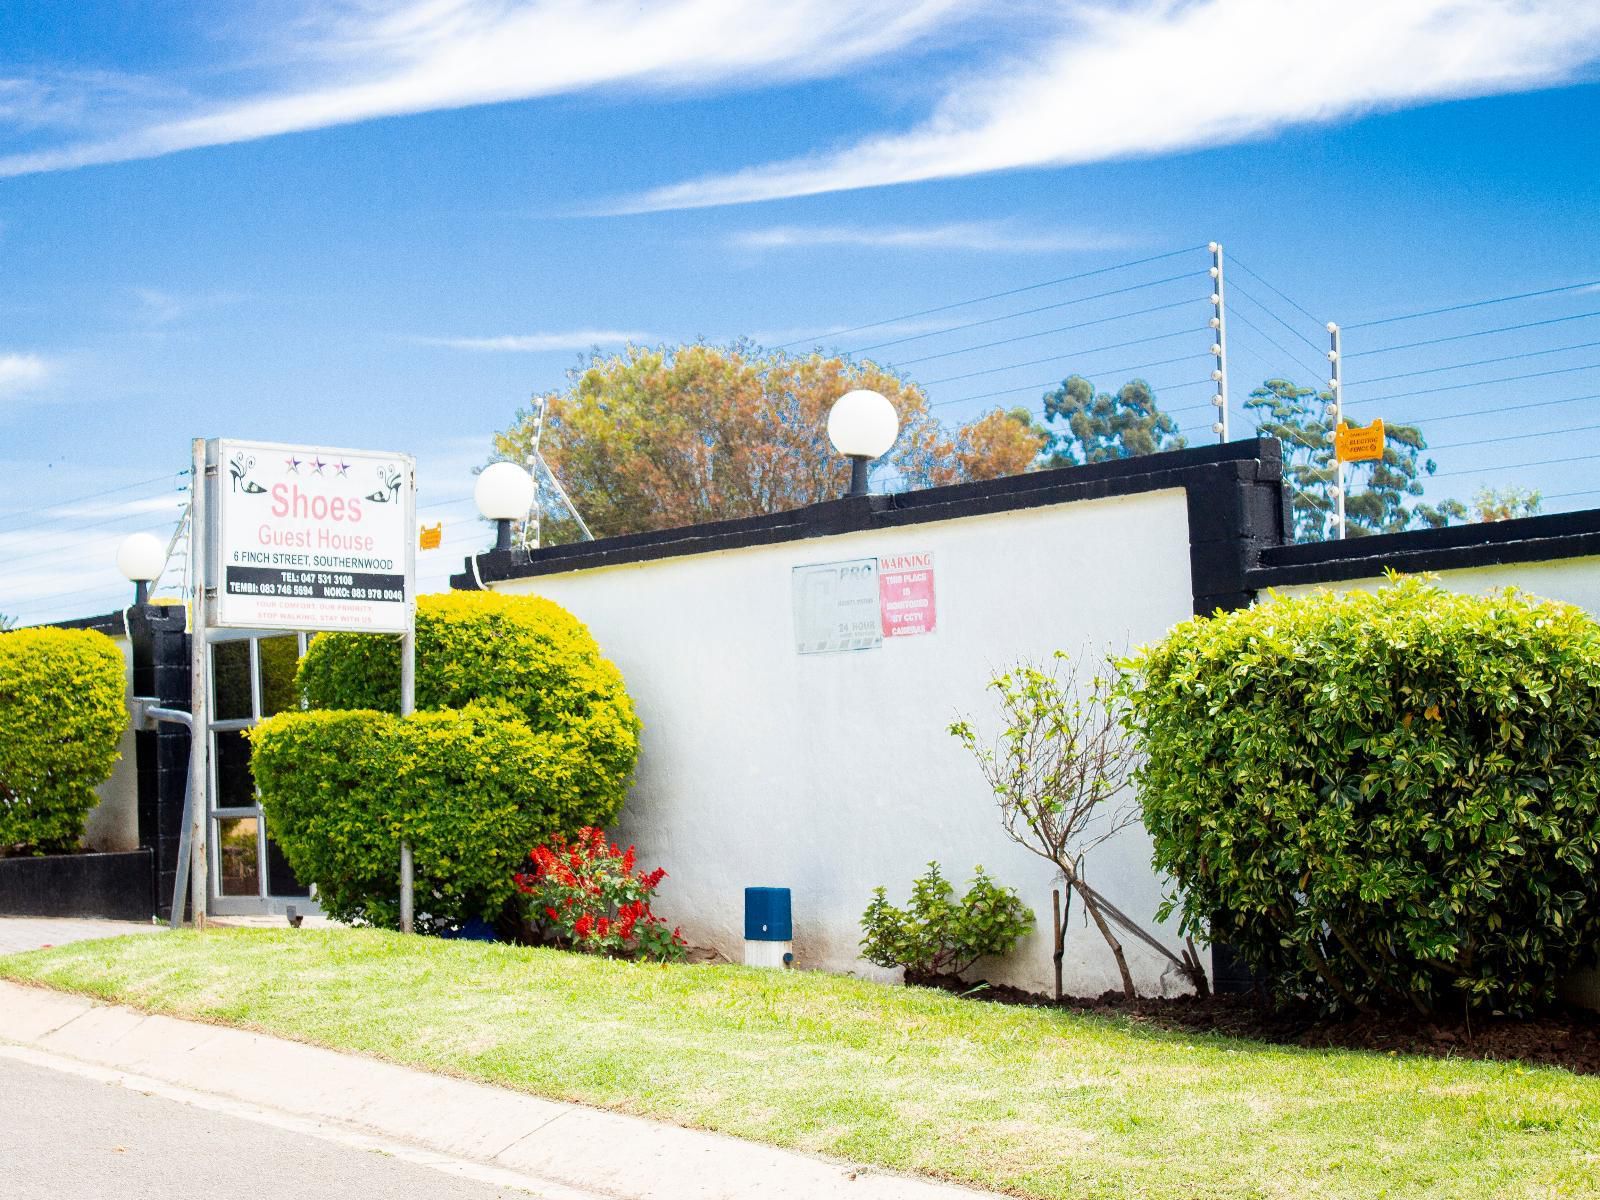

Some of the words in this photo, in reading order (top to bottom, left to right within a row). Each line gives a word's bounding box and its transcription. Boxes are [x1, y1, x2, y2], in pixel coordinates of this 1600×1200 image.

[271, 482, 362, 522] Shoes
[258, 524, 311, 548] Guest
[318, 527, 374, 551] House
[233, 550, 239, 562] 6
[241, 551, 270, 564] FINCH
[272, 553, 311, 567] STREET,
[313, 555, 393, 570] SOUTHERNWOOD
[881, 554, 930, 569] WARNING
[281, 571, 300, 583] TEL:
[300, 573, 316, 584] 047
[317, 574, 332, 585] 531
[333, 575, 354, 586] 3108
[903, 573, 928, 583] PLACE
[230, 581, 259, 593] TEMBI:
[259, 583, 275, 595] 083
[276, 584, 293, 595] 746
[323, 586, 351, 598] NOKO:
[351, 588, 367, 599] 083
[367, 589, 383, 600] 978
[886, 599, 929, 610] MONITORED
[903, 612, 924, 621] CCTV
[852, 620, 876, 631] HOUR
